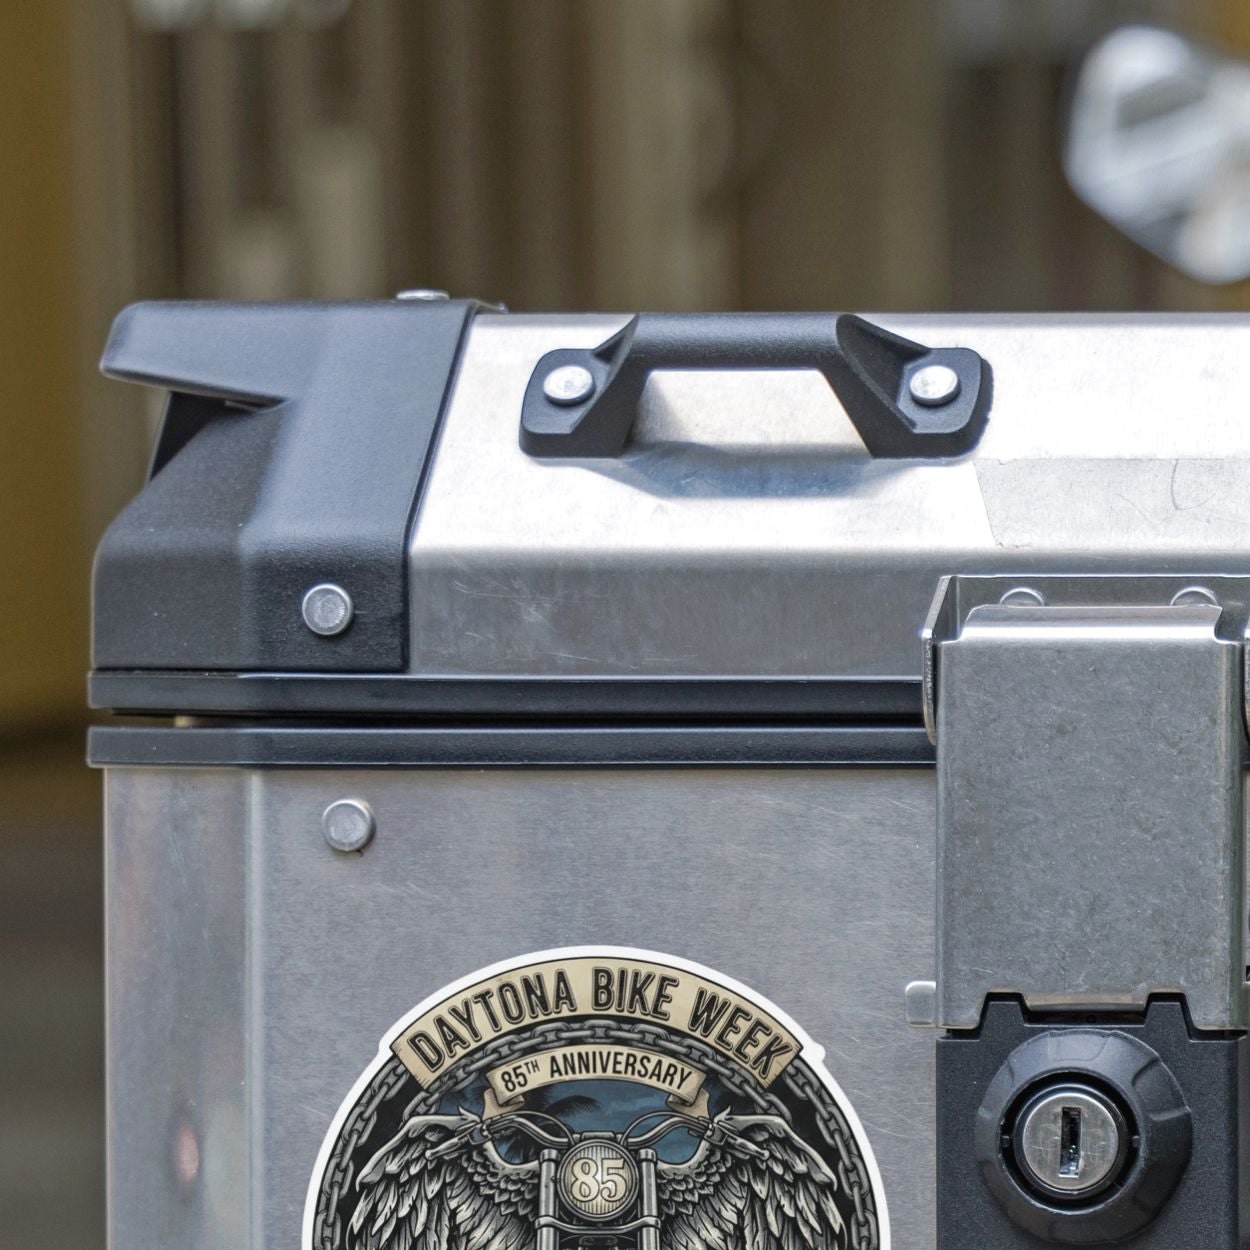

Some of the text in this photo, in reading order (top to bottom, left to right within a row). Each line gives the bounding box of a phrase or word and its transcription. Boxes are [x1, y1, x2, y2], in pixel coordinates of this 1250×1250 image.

[407, 967, 793, 1079] DAYTONA BIKE WEEK
[501, 1051, 693, 1094] 85TH ANNIVERSARY
[569, 1157, 629, 1203] 85
